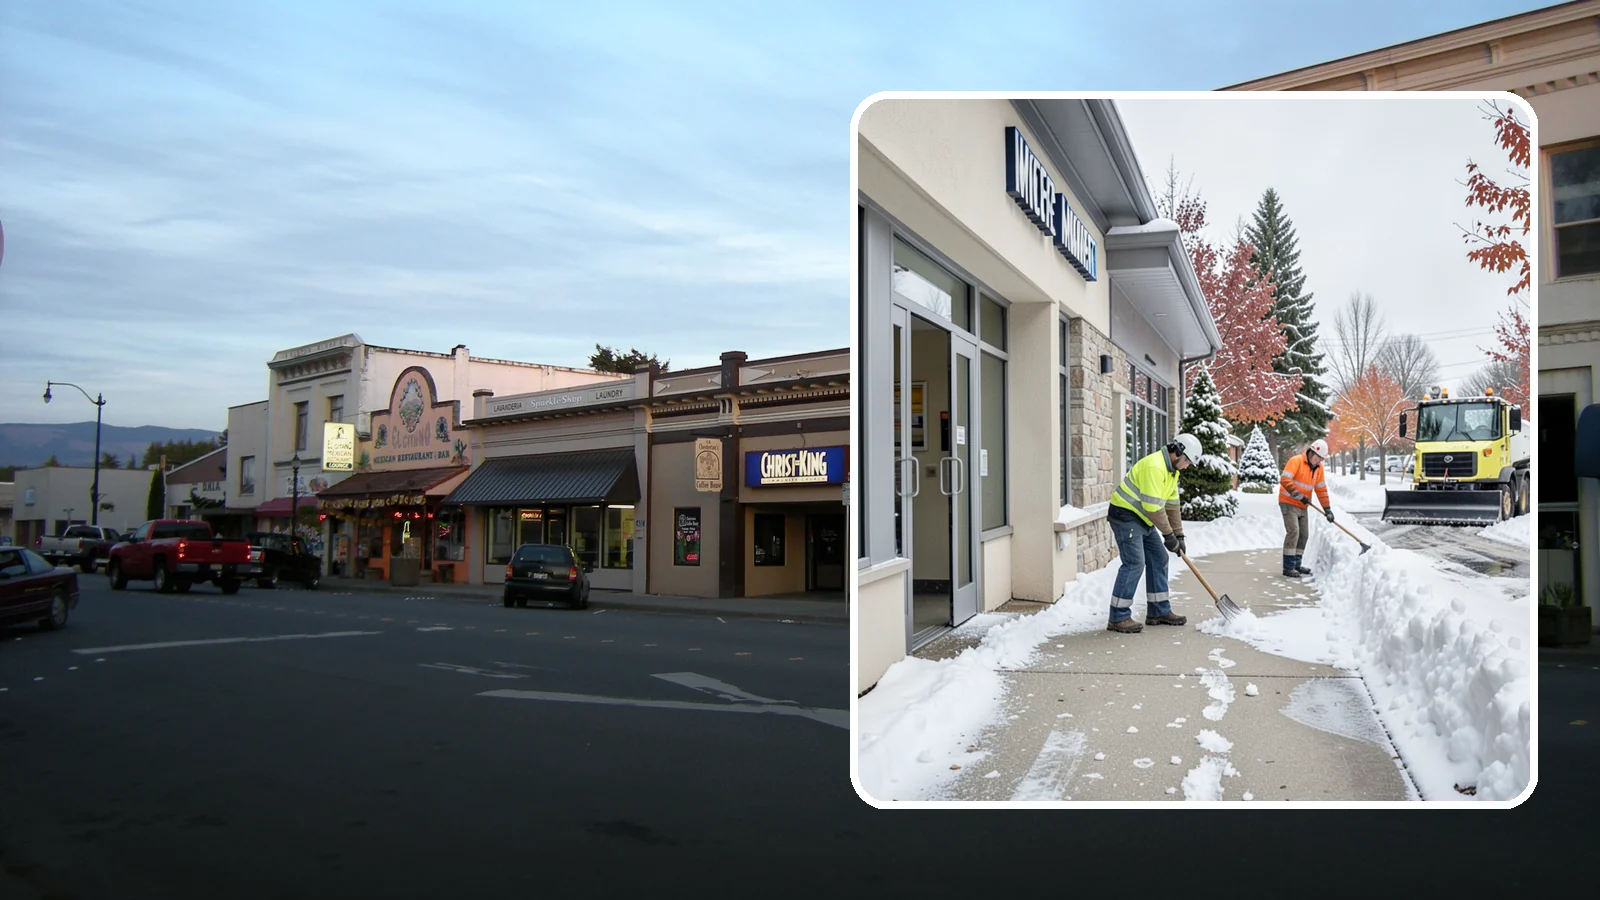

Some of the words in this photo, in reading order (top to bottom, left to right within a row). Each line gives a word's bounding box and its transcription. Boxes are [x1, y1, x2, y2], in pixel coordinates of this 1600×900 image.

[493, 402, 522, 413] LAVANDERIA
[562, 394, 583, 405] Shop
[595, 389, 624, 400] LAUNDRY
[397, 451, 433, 462] RESTAURANT
[437, 450, 450, 459] BAR
[761, 452, 797, 478] CHRIST
[798, 450, 828, 476] KING
